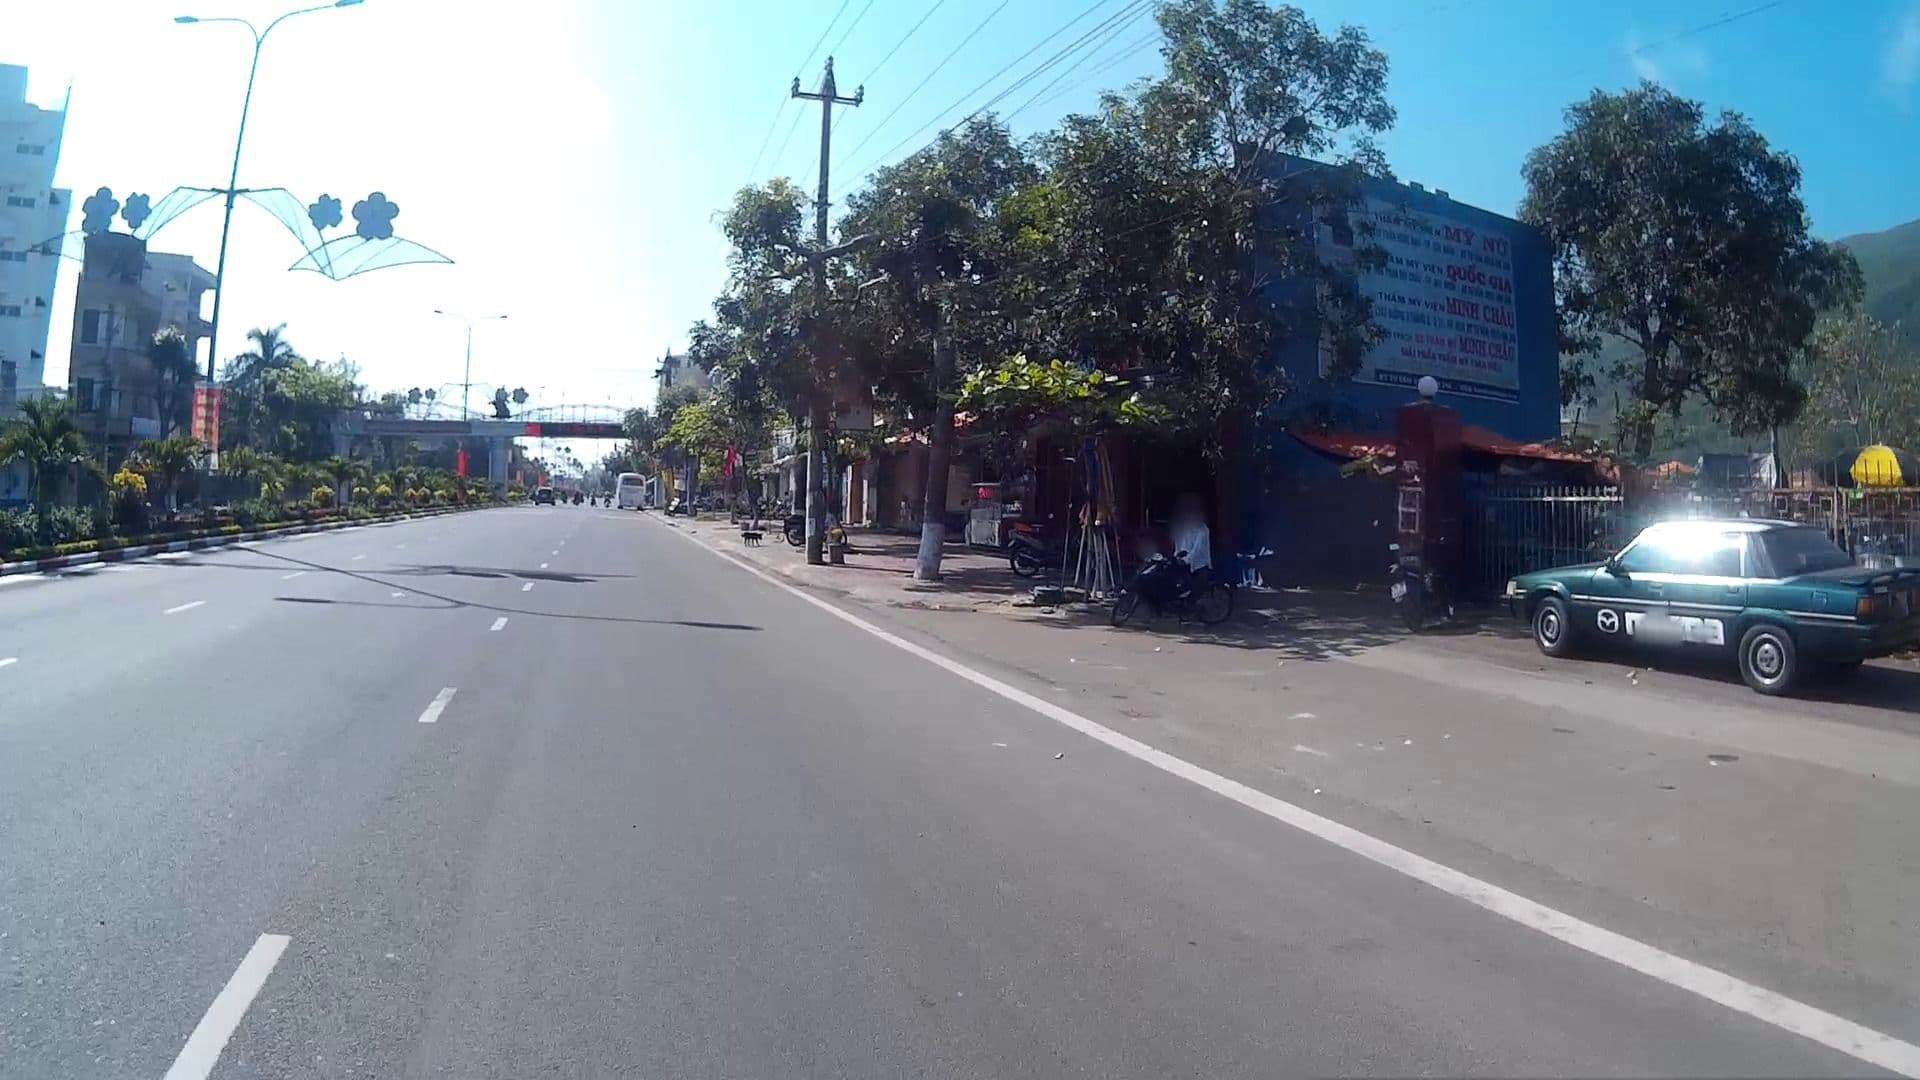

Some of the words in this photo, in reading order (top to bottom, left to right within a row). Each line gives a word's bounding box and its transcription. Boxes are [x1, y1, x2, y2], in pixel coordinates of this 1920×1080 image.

[1447, 263, 1486, 286] QUỐC
[1446, 296, 1479, 320] MINH
[1459, 335, 1486, 357] MINH
